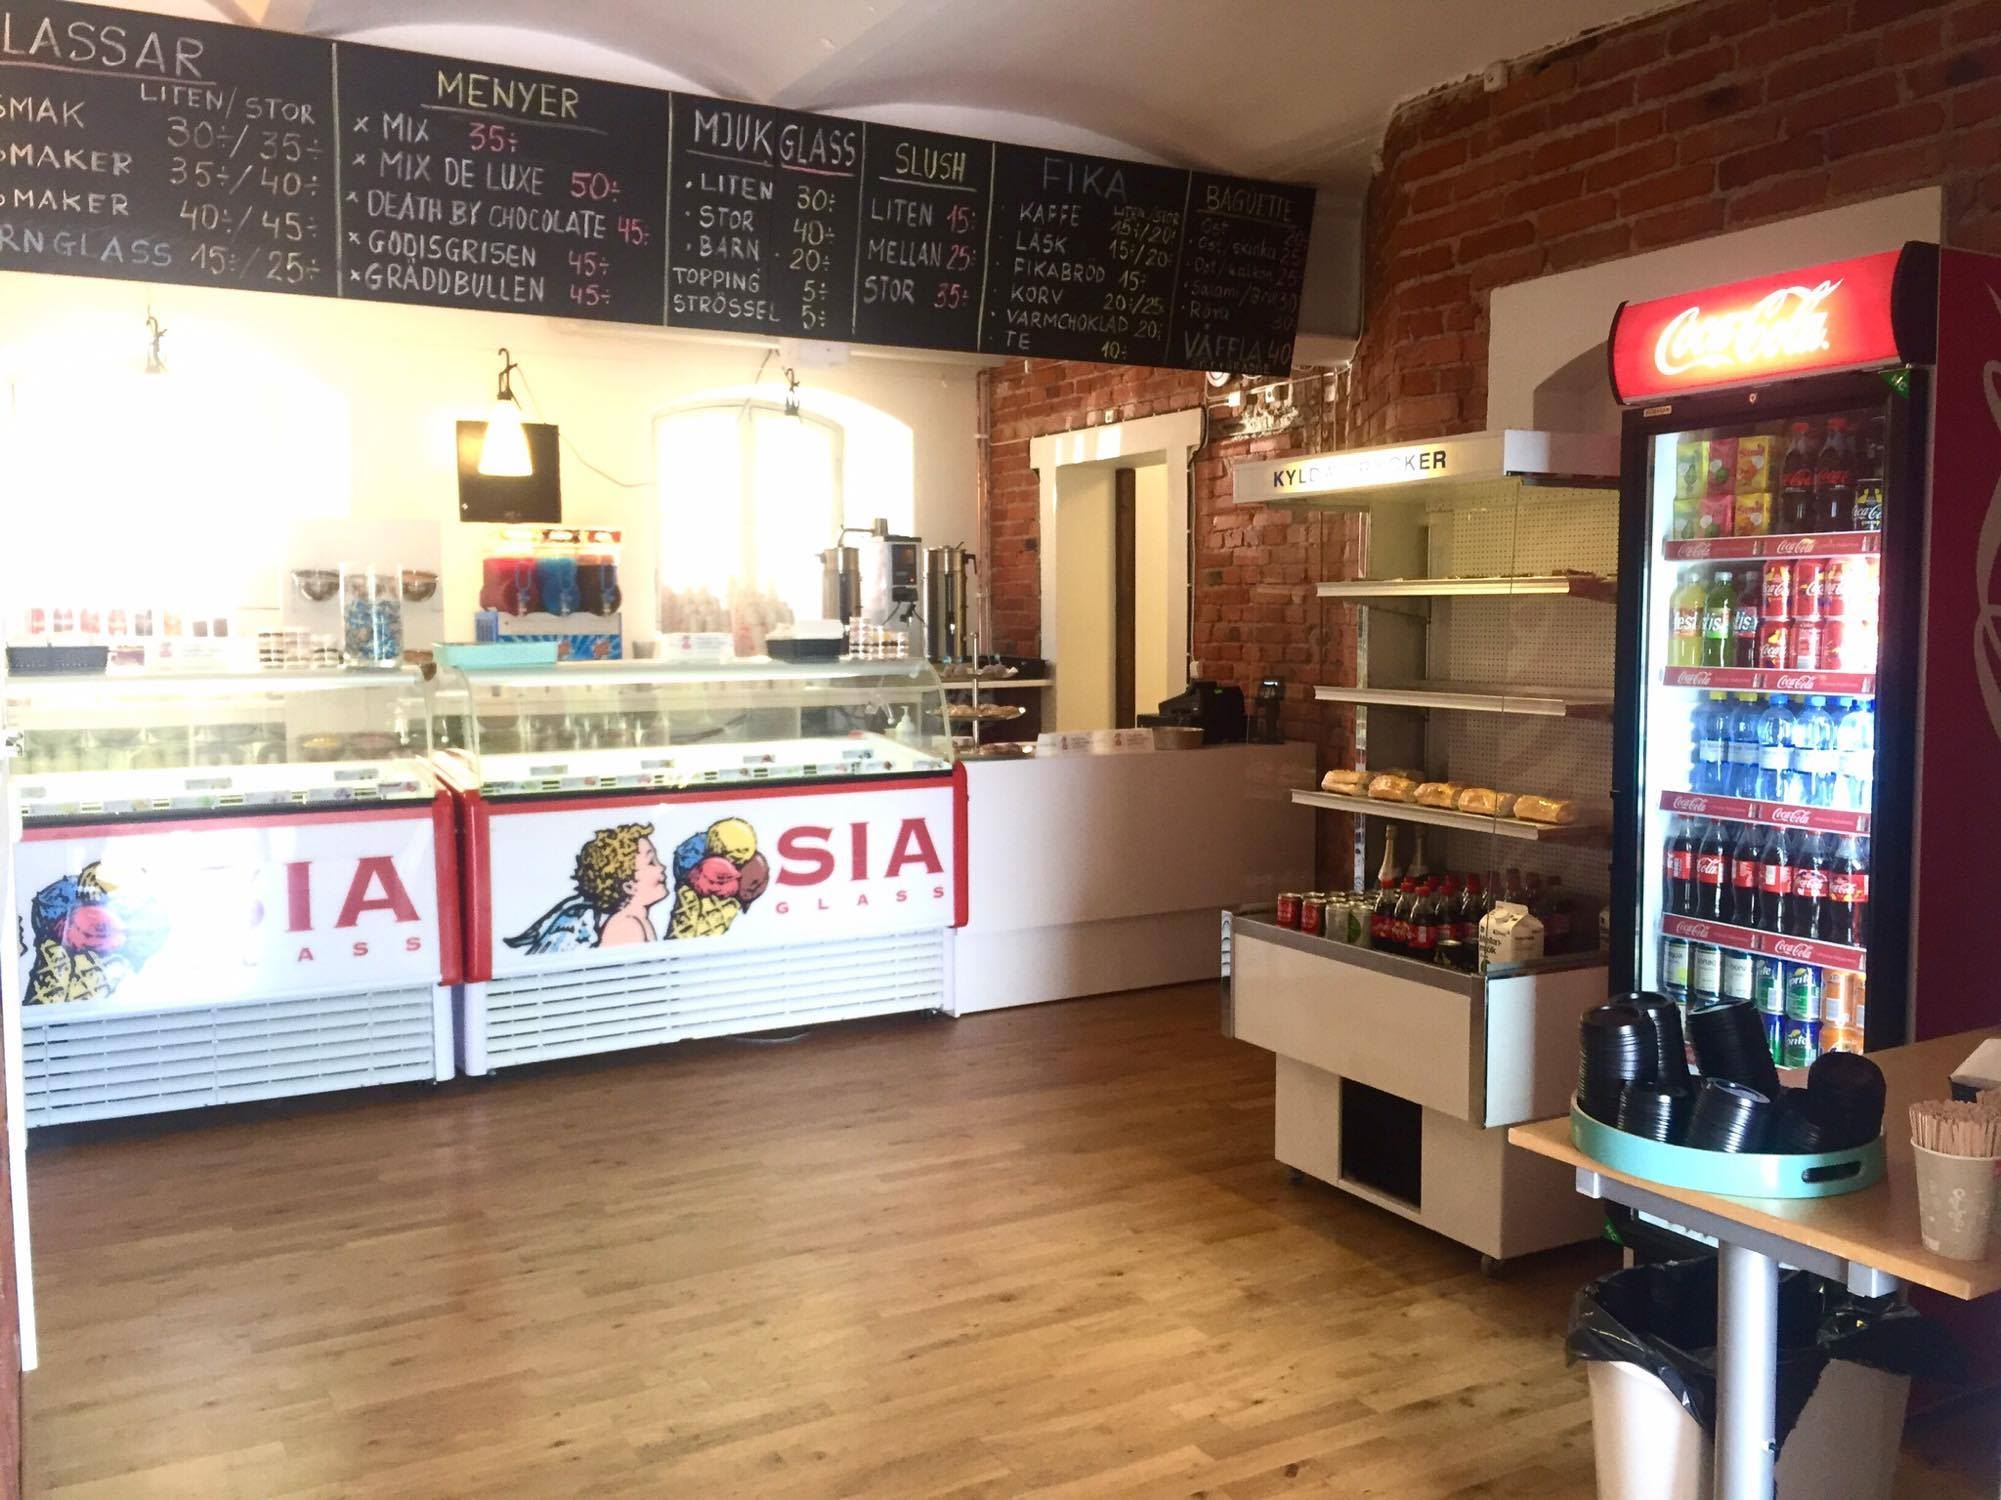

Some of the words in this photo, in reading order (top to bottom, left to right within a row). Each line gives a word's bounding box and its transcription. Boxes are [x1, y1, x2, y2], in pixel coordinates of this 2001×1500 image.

[437, 70, 579, 119] MENYER
[246, 98, 316, 126] STOR
[383, 112, 429, 143] MIX
[693, 109, 774, 157] MJUK
[778, 123, 857, 168] GLASS
[380, 151, 432, 182] MIX
[444, 156, 475, 188] DE
[486, 161, 545, 197] LUXE
[895, 142, 967, 183] SLUSH
[1042, 155, 1128, 201] FIKA
[701, 172, 774, 201] LITEN
[367, 189, 443, 224] DEATH
[449, 199, 482, 226] BY
[488, 205, 607, 240] CHOCOLATE
[699, 205, 755, 232] STOR
[871, 197, 934, 228] LITEN
[1018, 200, 1082, 227] KAFFE
[368, 229, 537, 268] GODISGRISEN
[699, 235, 761, 262] BARN
[867, 238, 942, 268] MELLAN
[364, 258, 545, 303] GRÄDDBULLEN
[672, 266, 761, 295] TOPPING
[1013, 257, 1105, 284] FIKABRÖD
[863, 275, 915, 305] STOR
[1010, 285, 1065, 306] KORV
[672, 292, 782, 323] STRÖSSEL
[1006, 308, 1129, 333] VARMCHOKLAD
[1005, 330, 1032, 350] TE
[776, 817, 945, 887] SIA
[775, 885, 946, 916] GLASS
